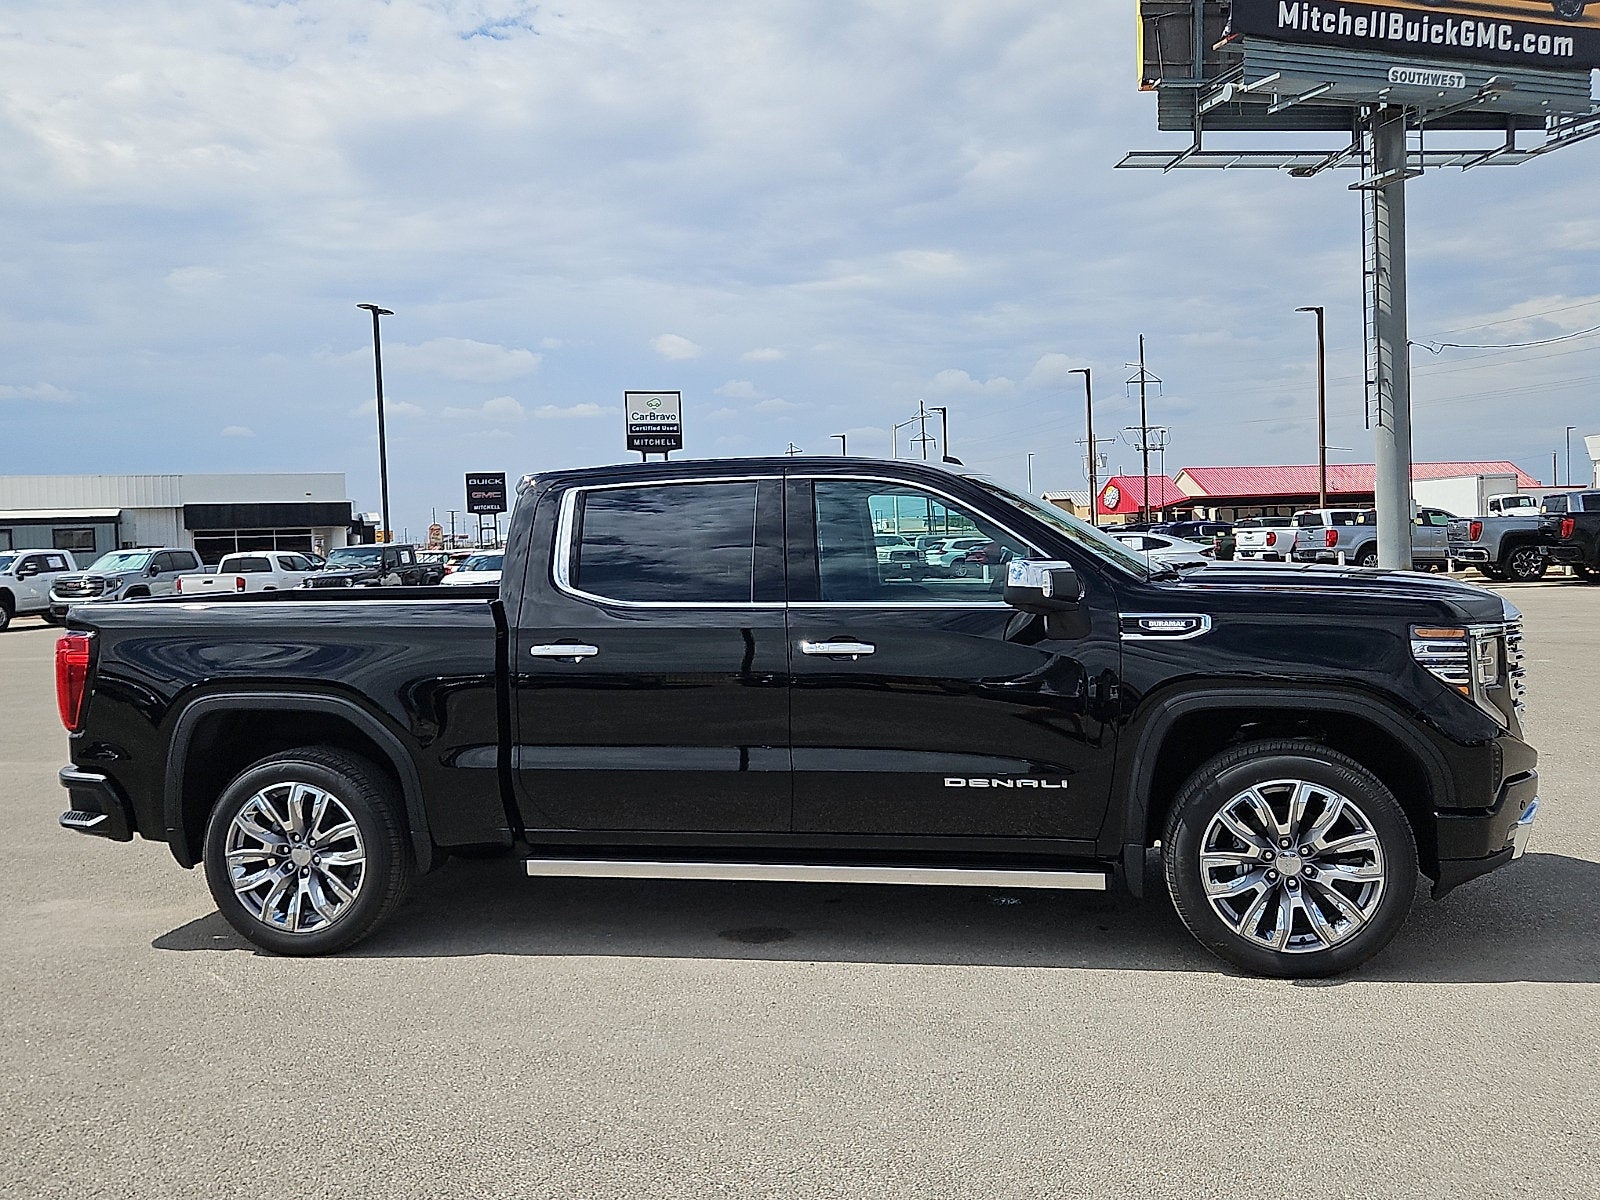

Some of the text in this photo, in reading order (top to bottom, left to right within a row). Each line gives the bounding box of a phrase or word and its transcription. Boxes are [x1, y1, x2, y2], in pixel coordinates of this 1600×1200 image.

[1278, 1, 1574, 57] MitchellBuickGMC.com
[1390, 69, 1464, 88] SOUTHWEST
[631, 412, 677, 421] CarBravo
[633, 438, 677, 446] MITCHELL
[471, 491, 502, 499] GMC
[943, 777, 1068, 789] DENALI
